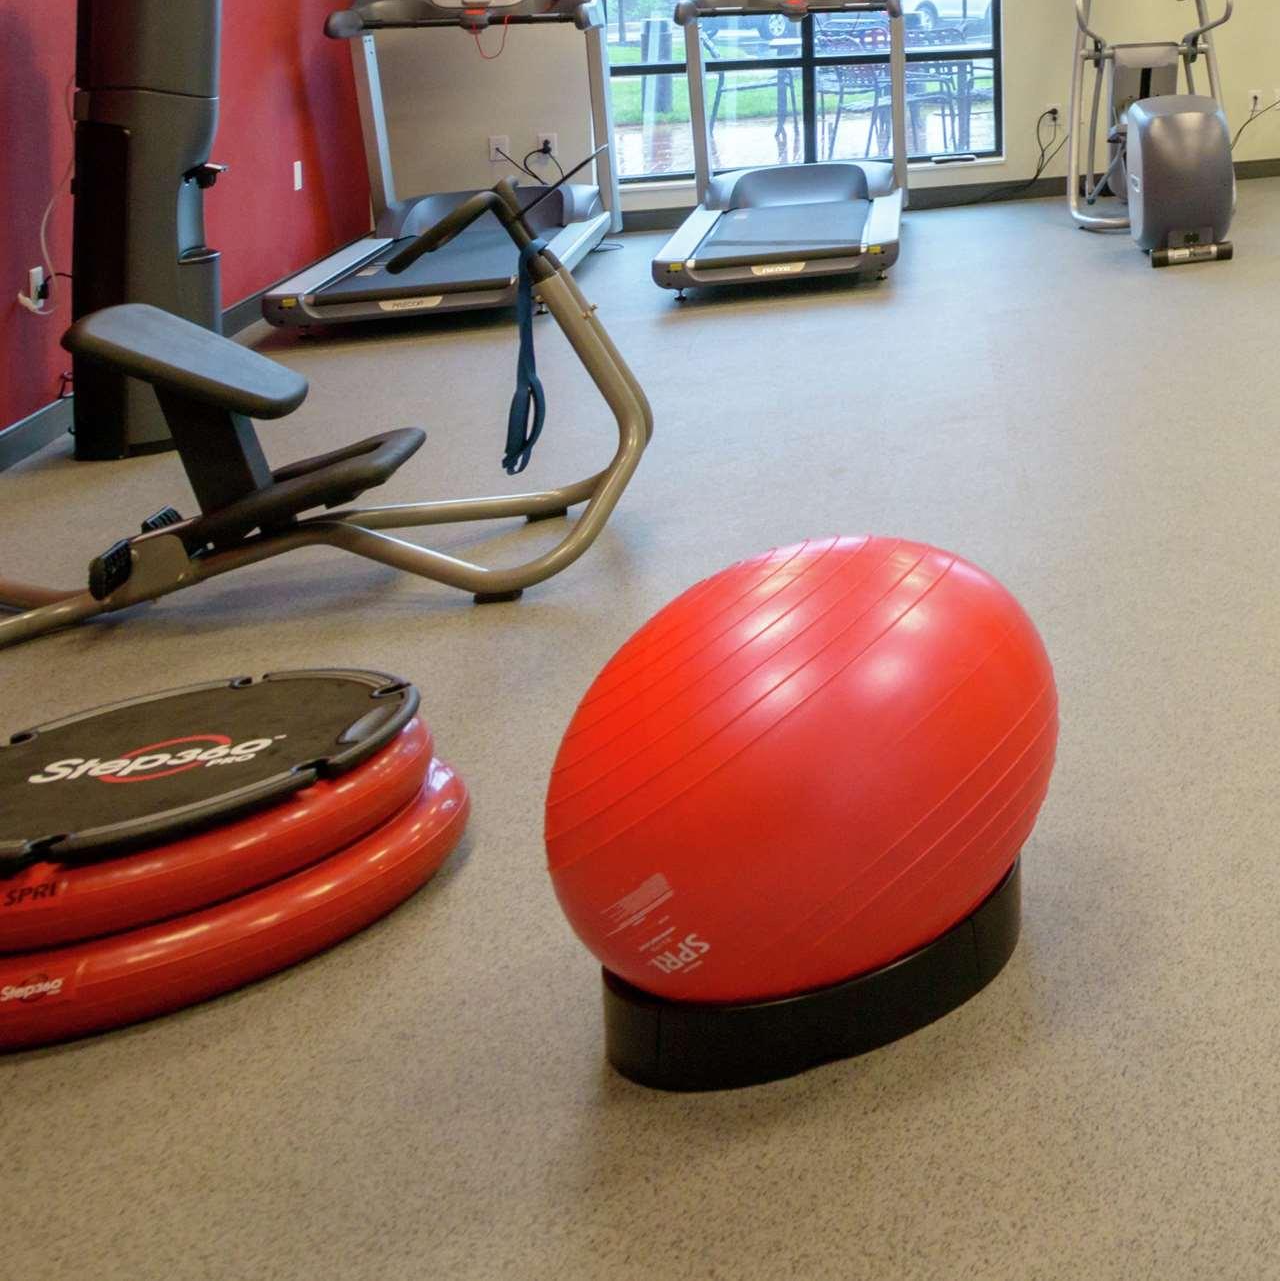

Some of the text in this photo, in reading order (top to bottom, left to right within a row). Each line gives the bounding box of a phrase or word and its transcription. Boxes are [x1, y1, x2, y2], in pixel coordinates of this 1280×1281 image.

[28, 737, 273, 784] Step360
[205, 753, 256, 767] PRO
[4, 880, 57, 907] SPRI
[650, 933, 710, 974] SPRI
